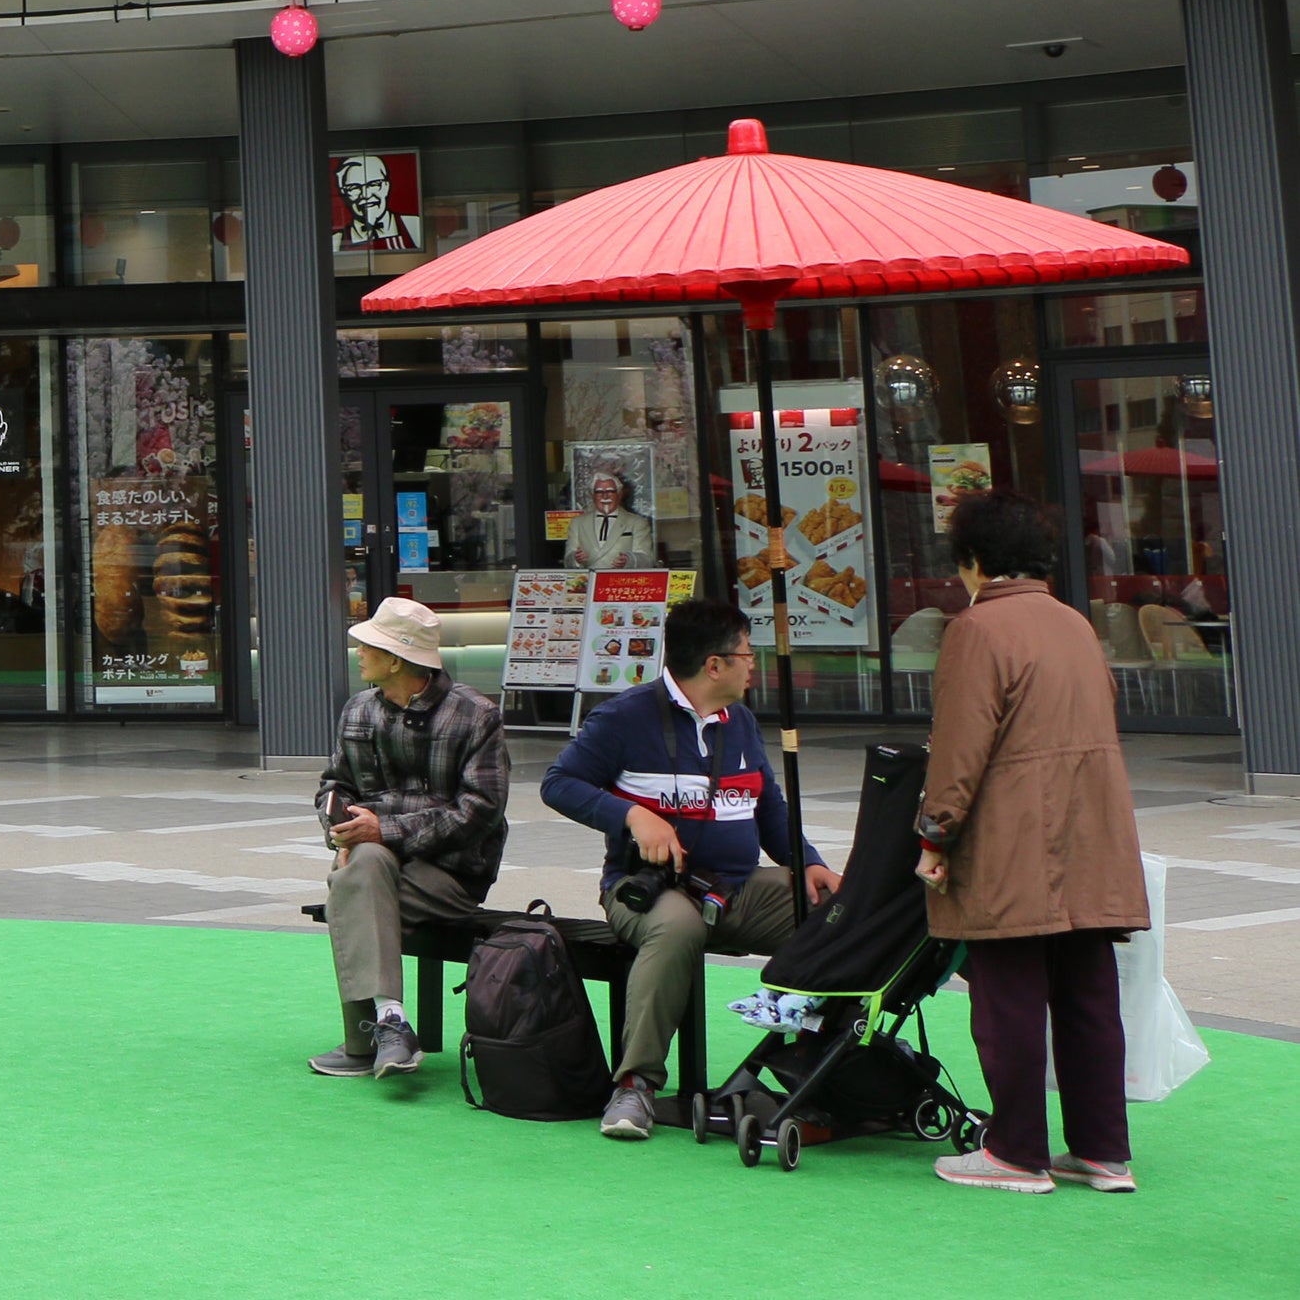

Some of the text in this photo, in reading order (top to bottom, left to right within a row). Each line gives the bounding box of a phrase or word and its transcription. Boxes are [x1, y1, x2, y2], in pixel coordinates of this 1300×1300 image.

[737, 432, 851, 454] よりり2パック
[780, 460, 854, 477] 1500円!
[96, 490, 192, 505] 食感たのしい、
[97, 509, 200, 526] まるごとポテト。
[102, 653, 169, 666] カーネリング
[102, 669, 136, 681] ポテト
